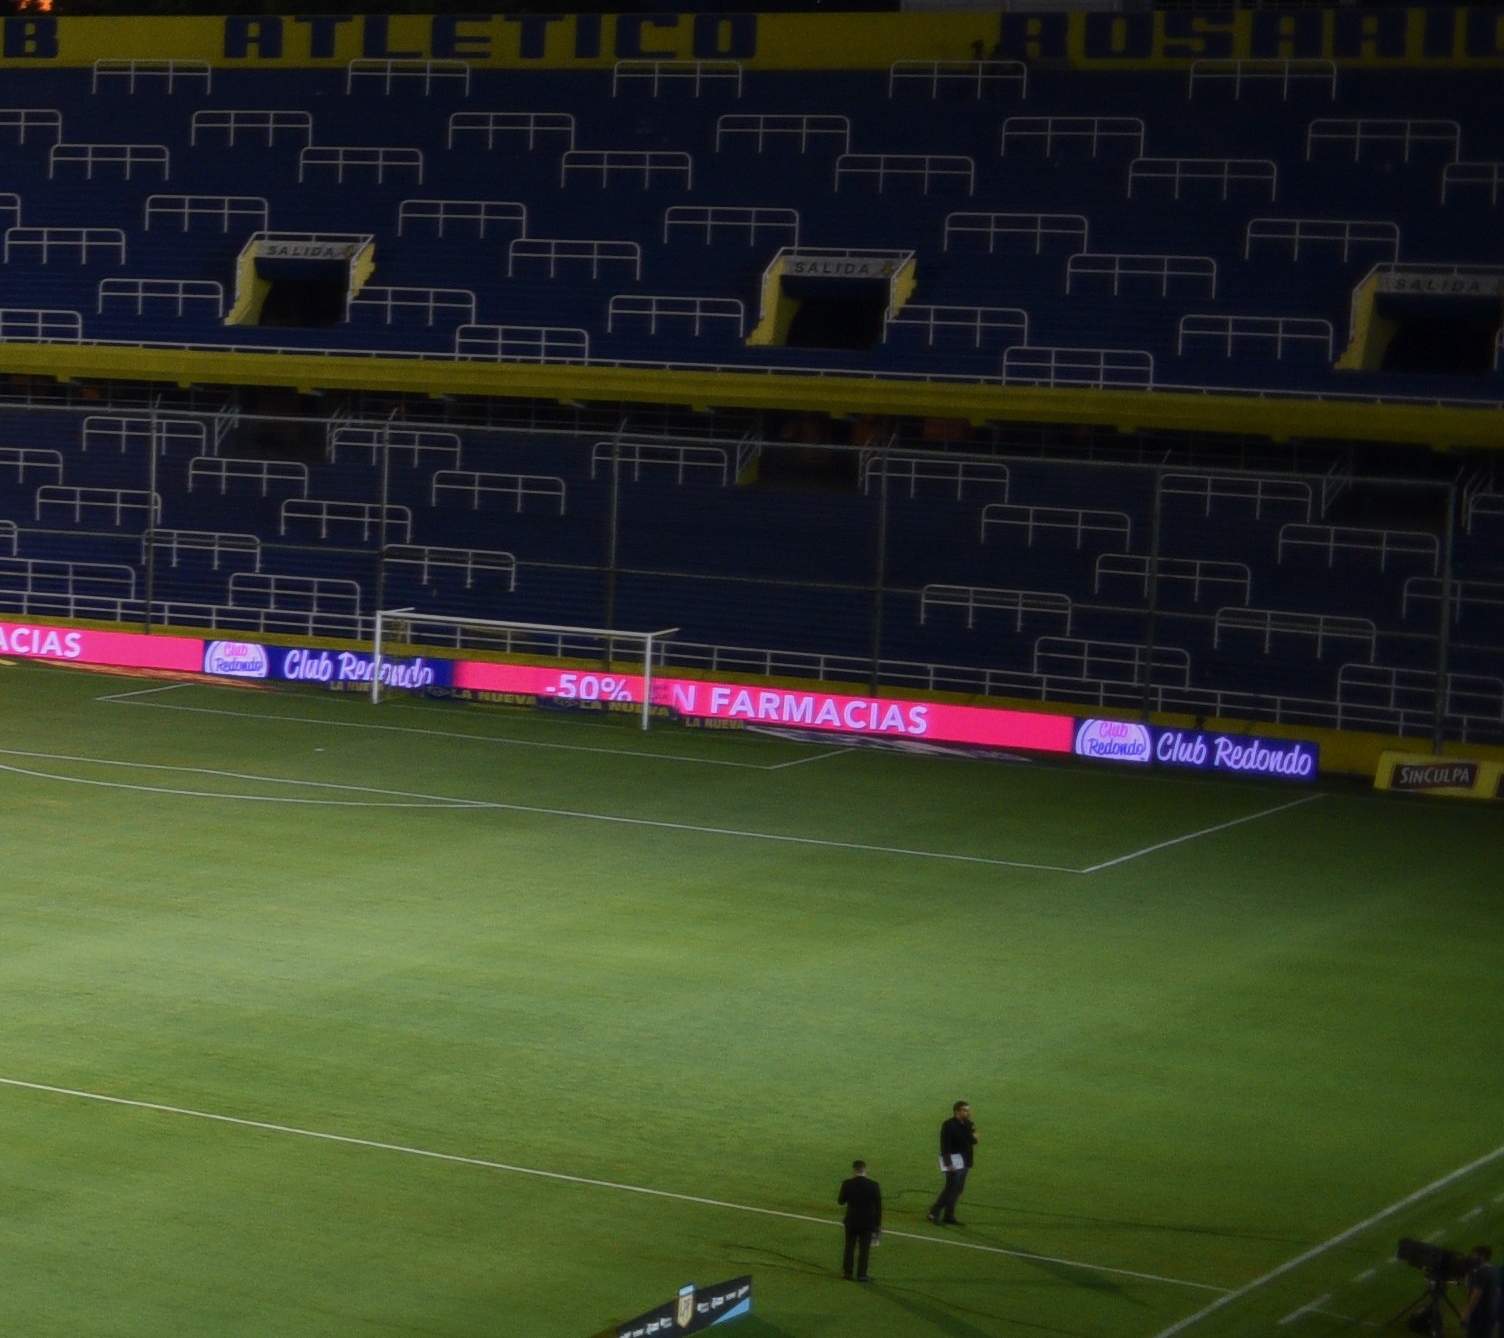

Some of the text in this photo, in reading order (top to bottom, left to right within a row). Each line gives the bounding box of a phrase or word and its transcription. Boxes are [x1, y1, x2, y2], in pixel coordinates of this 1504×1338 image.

[225, 13, 757, 61] ATLETICO
[268, 245, 334, 257] SALIDA
[795, 262, 869, 275] SALIDA
[1395, 280, 1480, 292] SALIDA
[284, 648, 435, 688] Club Redondo
[546, 673, 632, 703] -50%
[711, 686, 929, 734] FARMACIAS
[1157, 732, 1313, 776] Club Redondo
